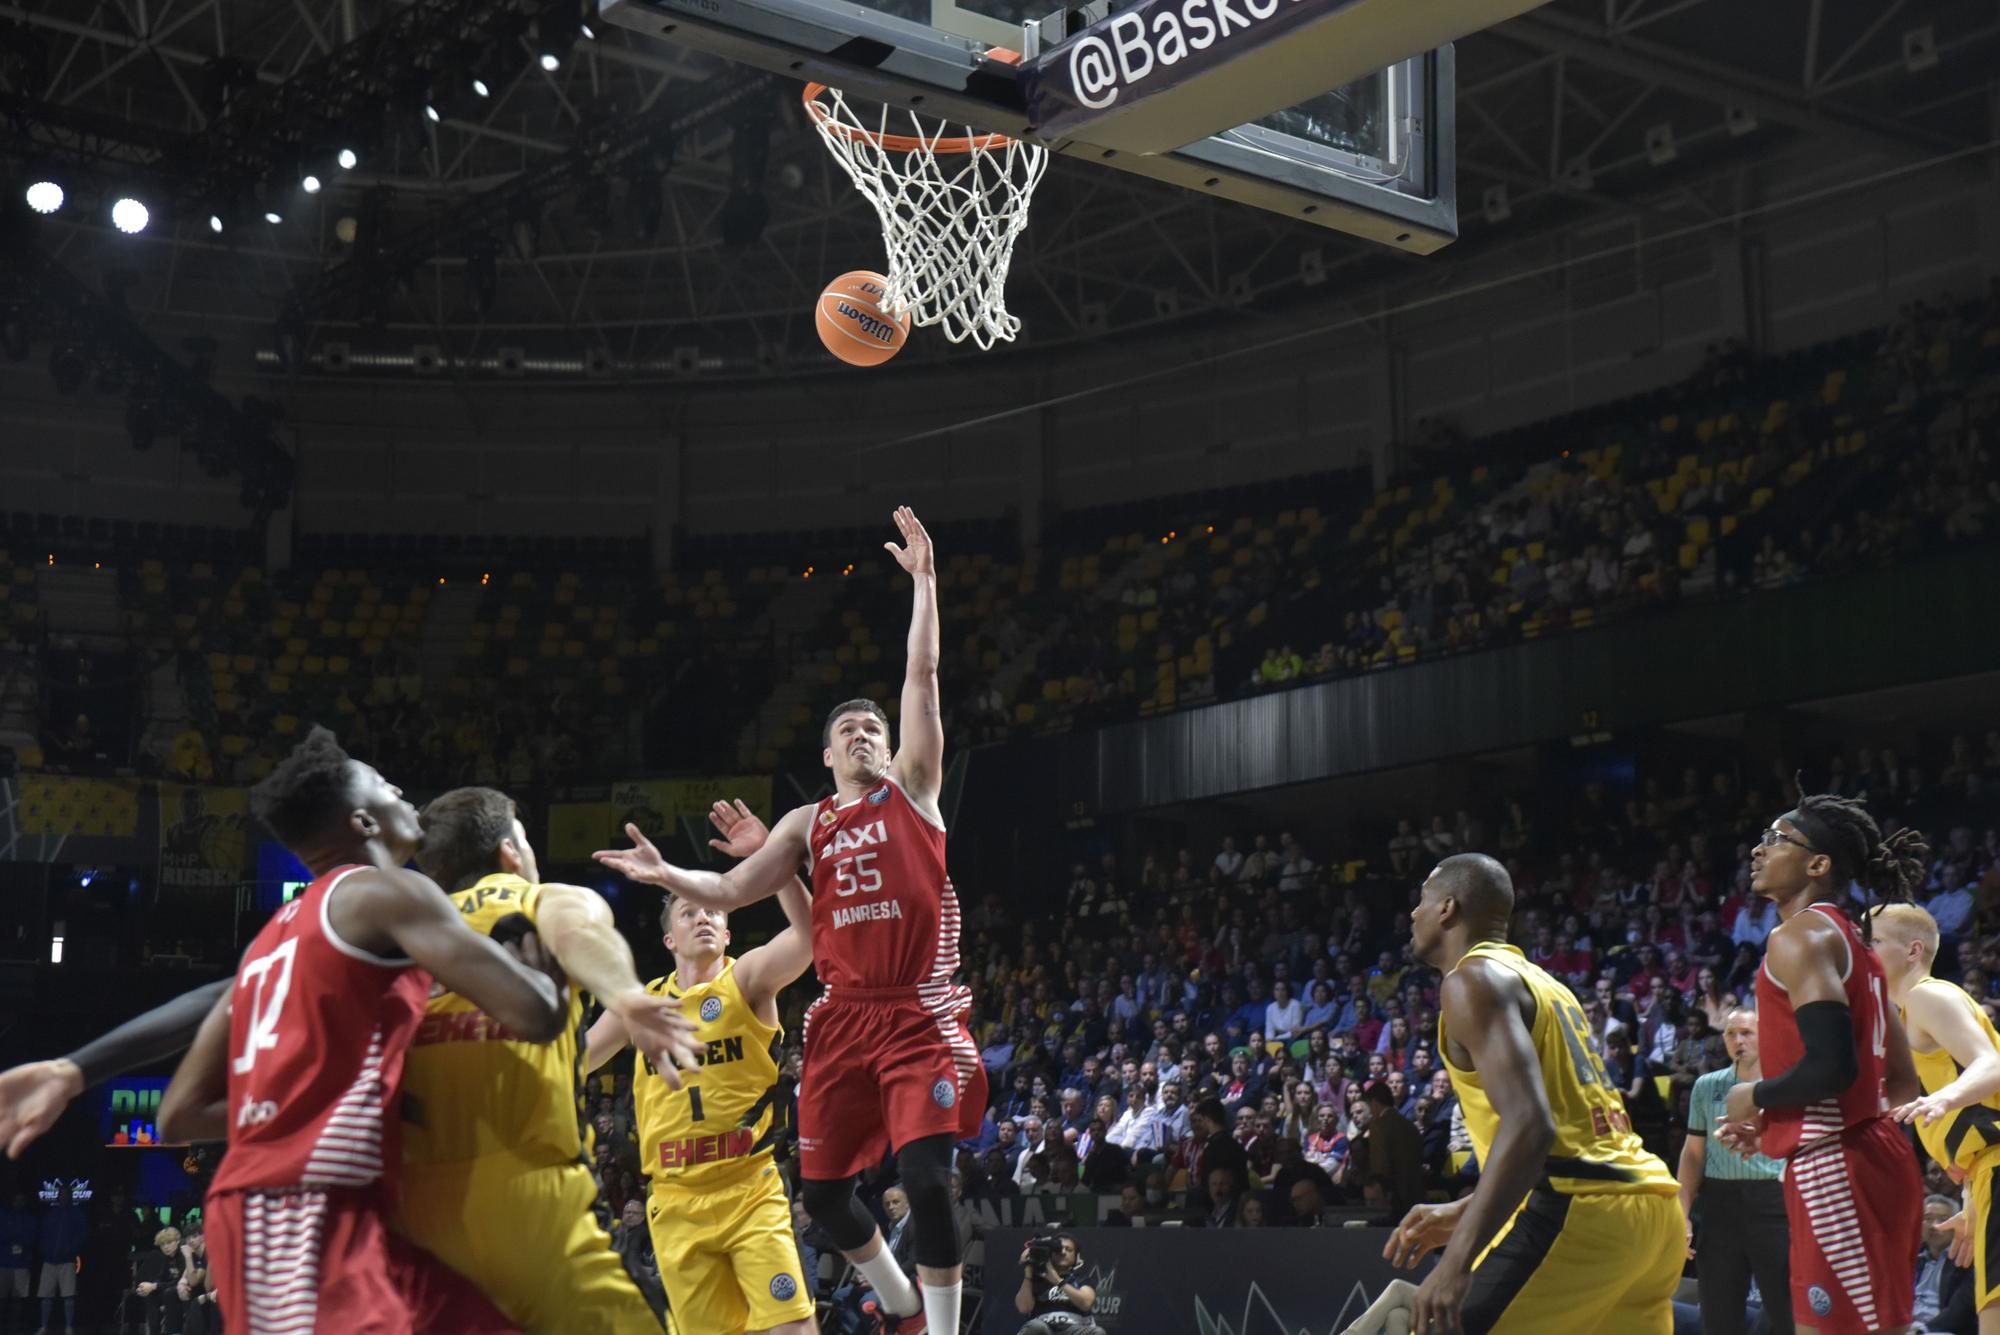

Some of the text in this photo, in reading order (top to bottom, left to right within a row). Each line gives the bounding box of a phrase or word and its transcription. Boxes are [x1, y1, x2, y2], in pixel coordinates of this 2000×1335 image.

[1069, 0, 1305, 109] @Bask
[837, 300, 894, 344] Wilson
[833, 851, 883, 897] 55
[688, 1085, 705, 1122] 1
[659, 1126, 754, 1169] EHEIM
[1091, 1295, 1121, 1315] OUR
